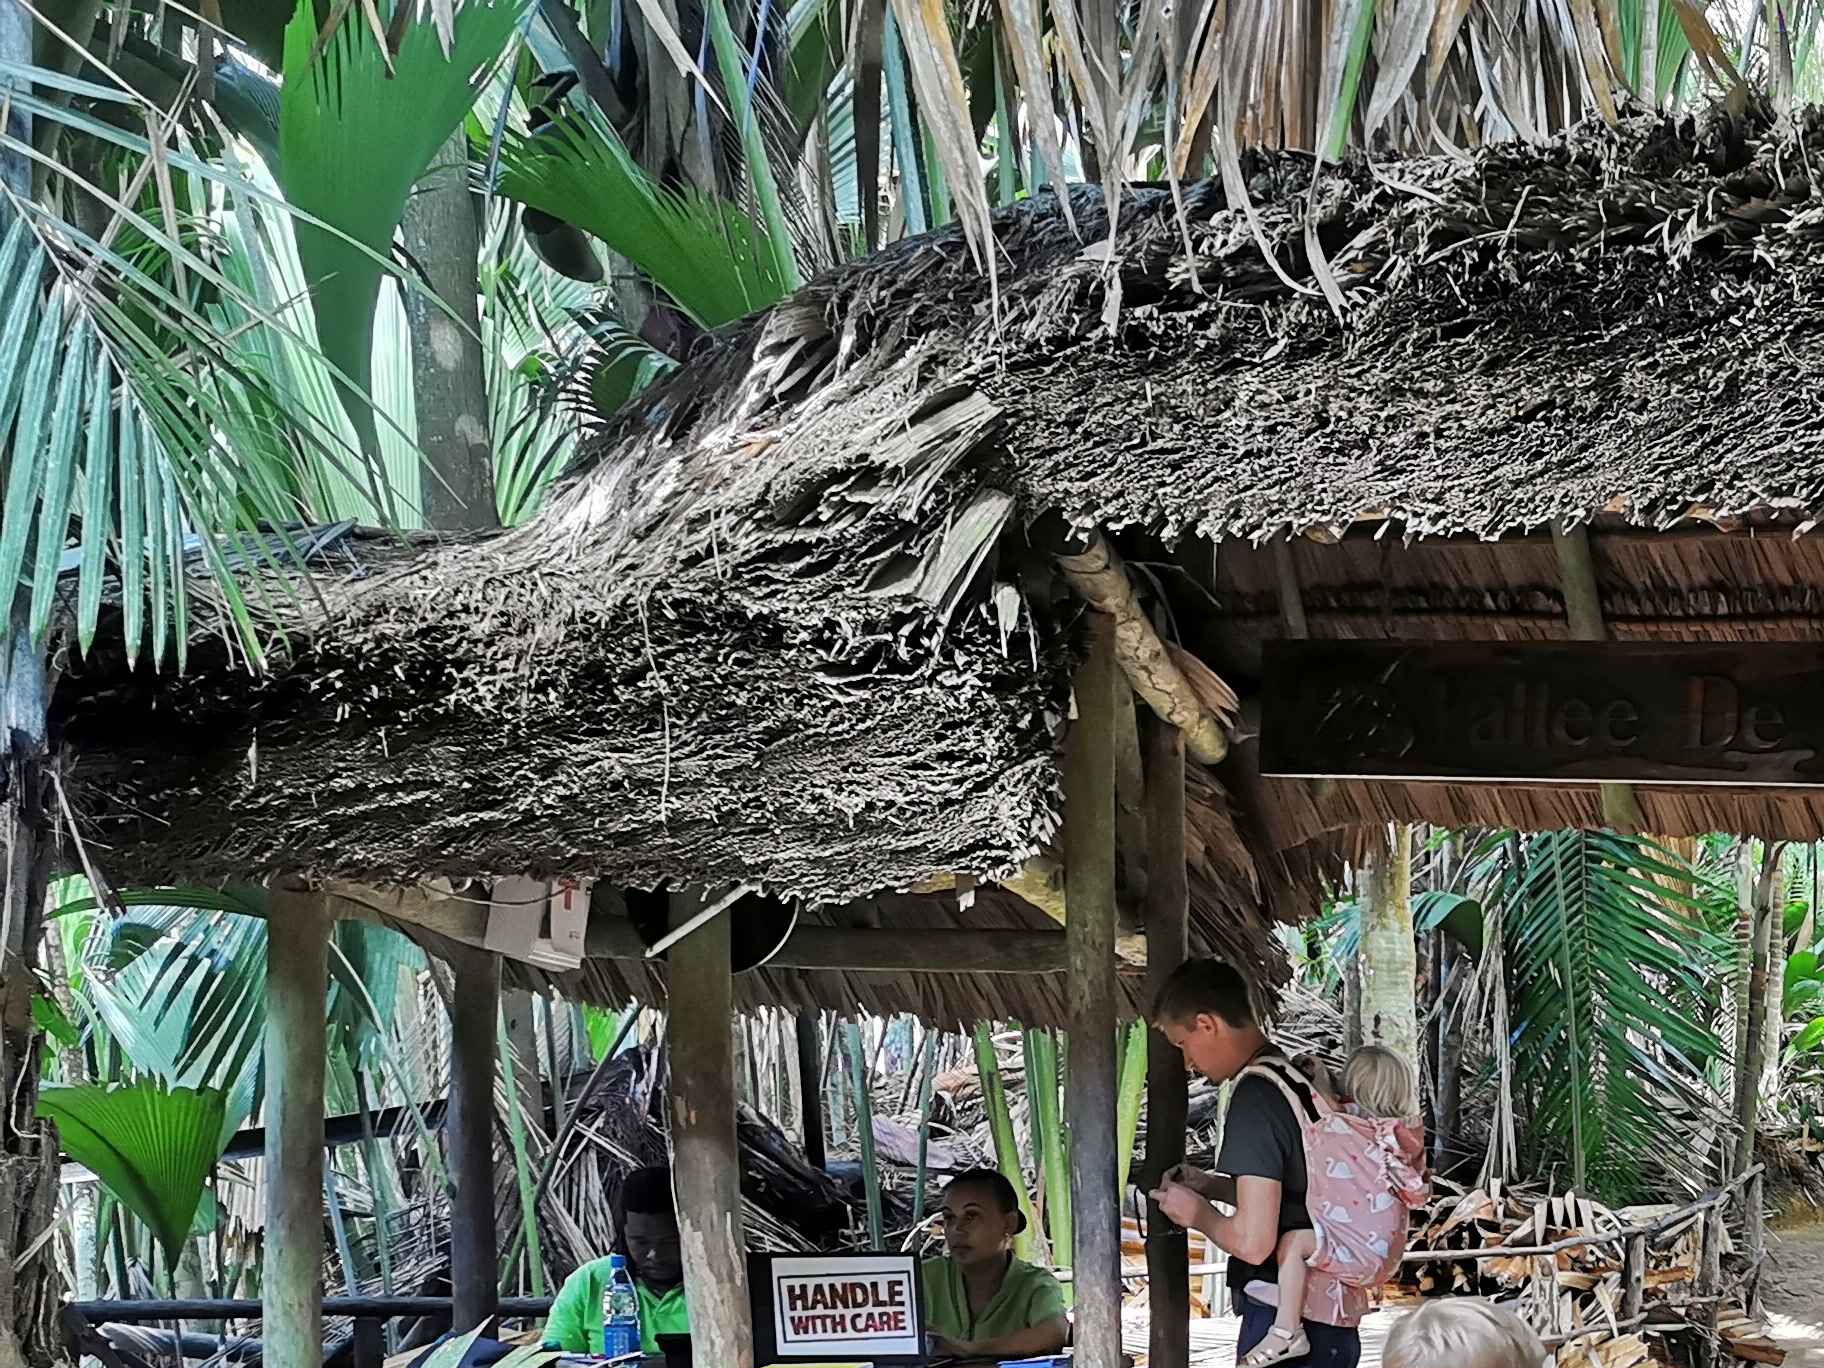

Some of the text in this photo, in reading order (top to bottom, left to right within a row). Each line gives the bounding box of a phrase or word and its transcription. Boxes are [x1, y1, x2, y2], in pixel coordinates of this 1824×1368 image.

[1686, 675, 1785, 750] De
[786, 1279, 906, 1312] HANDLE
[789, 1311, 907, 1336] WITH CARE
